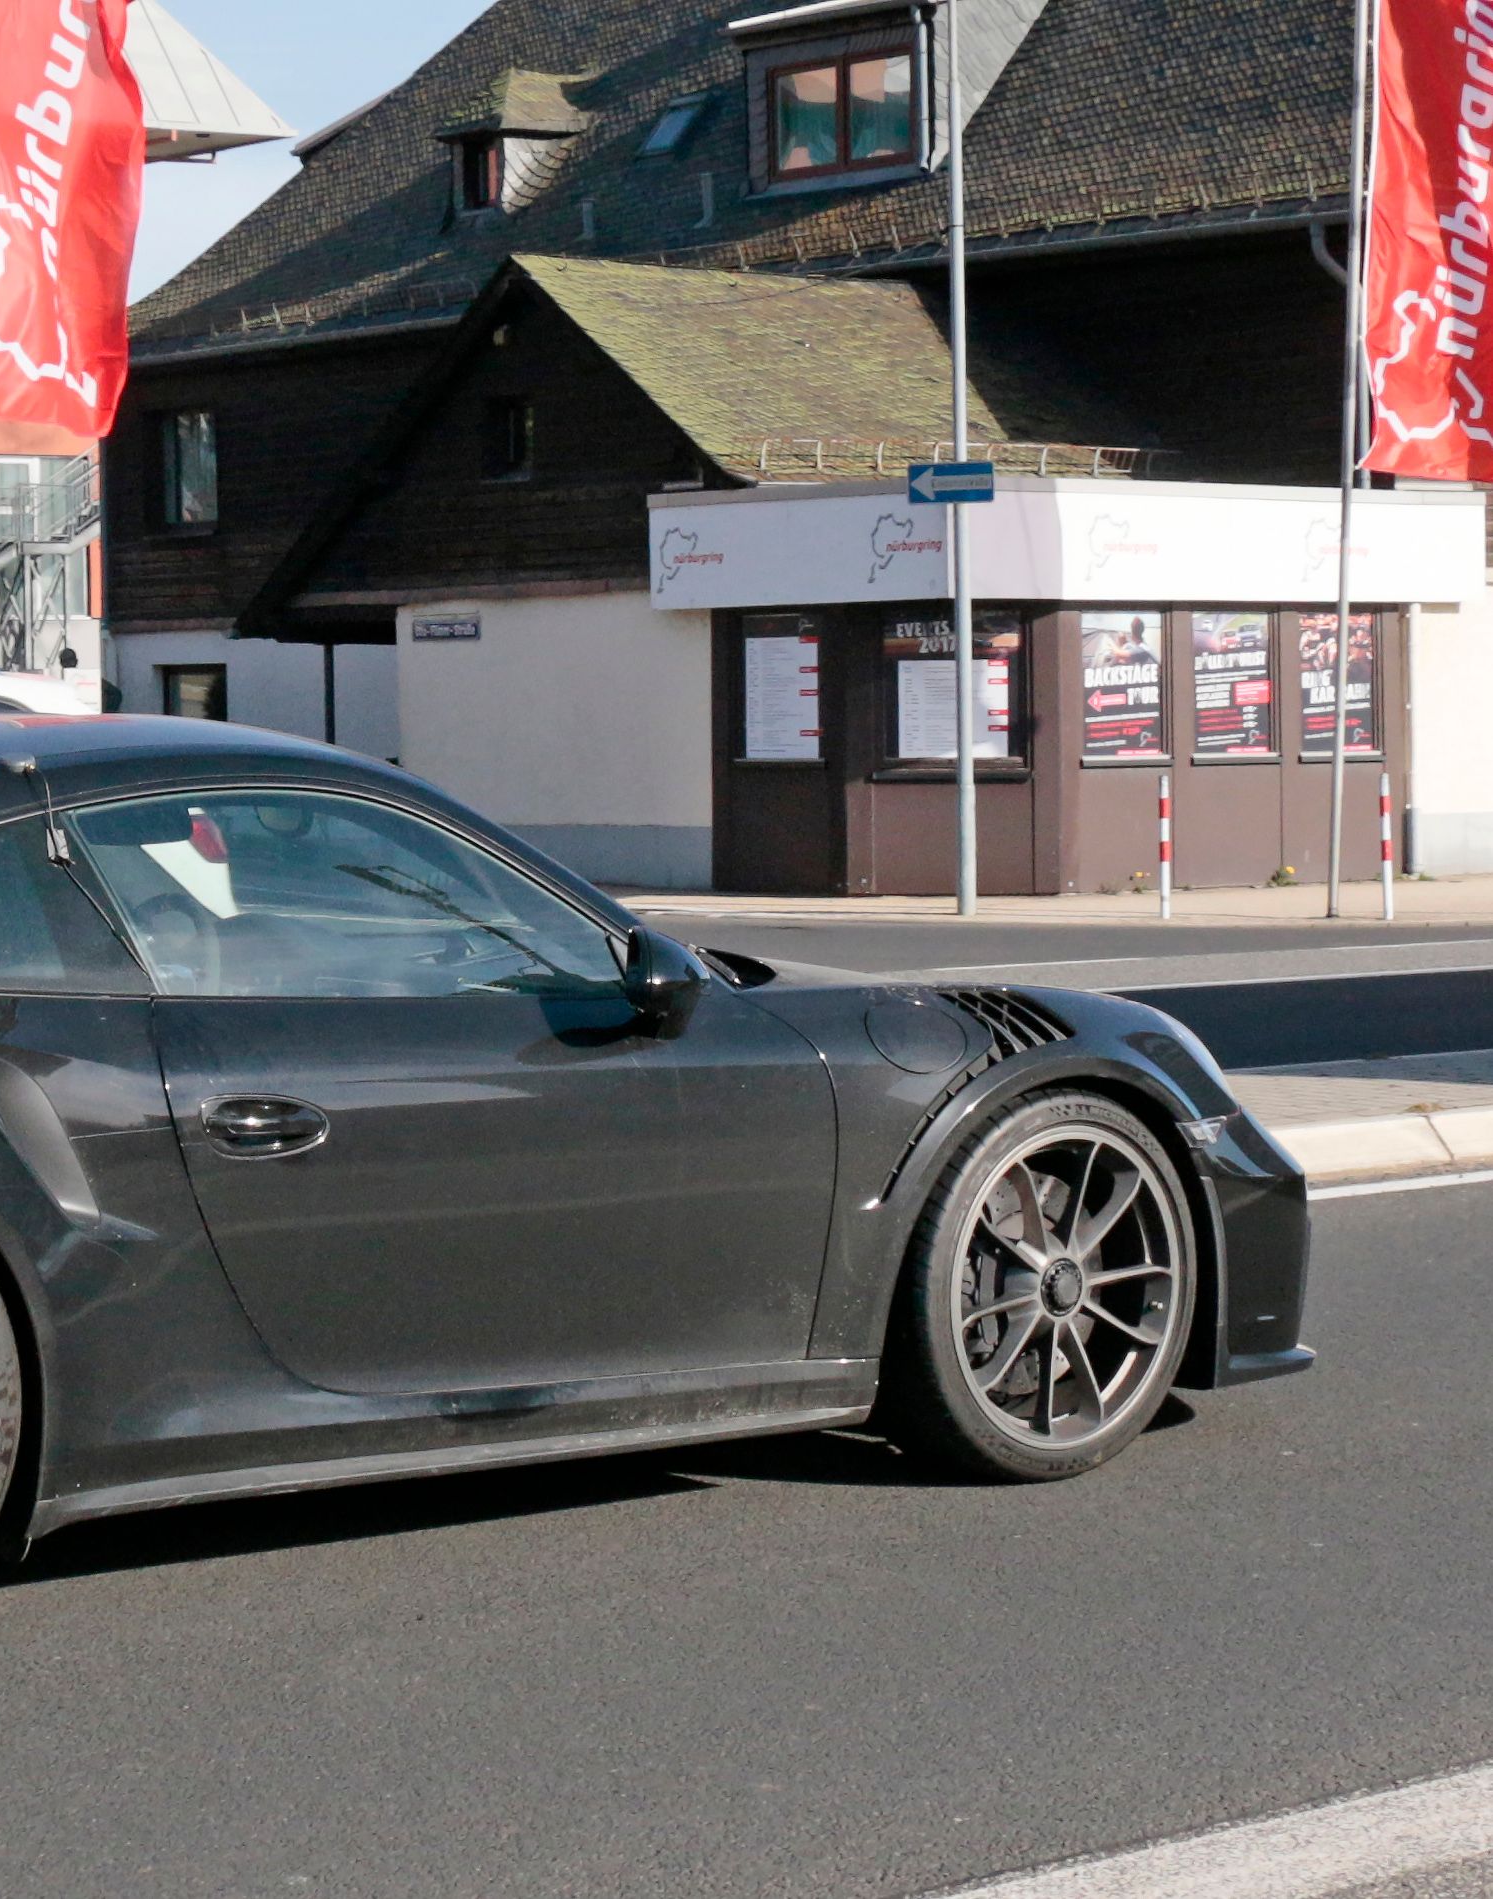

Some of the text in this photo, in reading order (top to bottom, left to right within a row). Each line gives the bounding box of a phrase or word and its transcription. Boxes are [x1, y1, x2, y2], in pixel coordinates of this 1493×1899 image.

[885, 540, 943, 553] nürburgring
[673, 552, 724, 566] nürburgring
[896, 620, 950, 637] EVENTS
[1084, 663, 1159, 688] BACKSTAGE
[1127, 686, 1159, 705] TOUR
